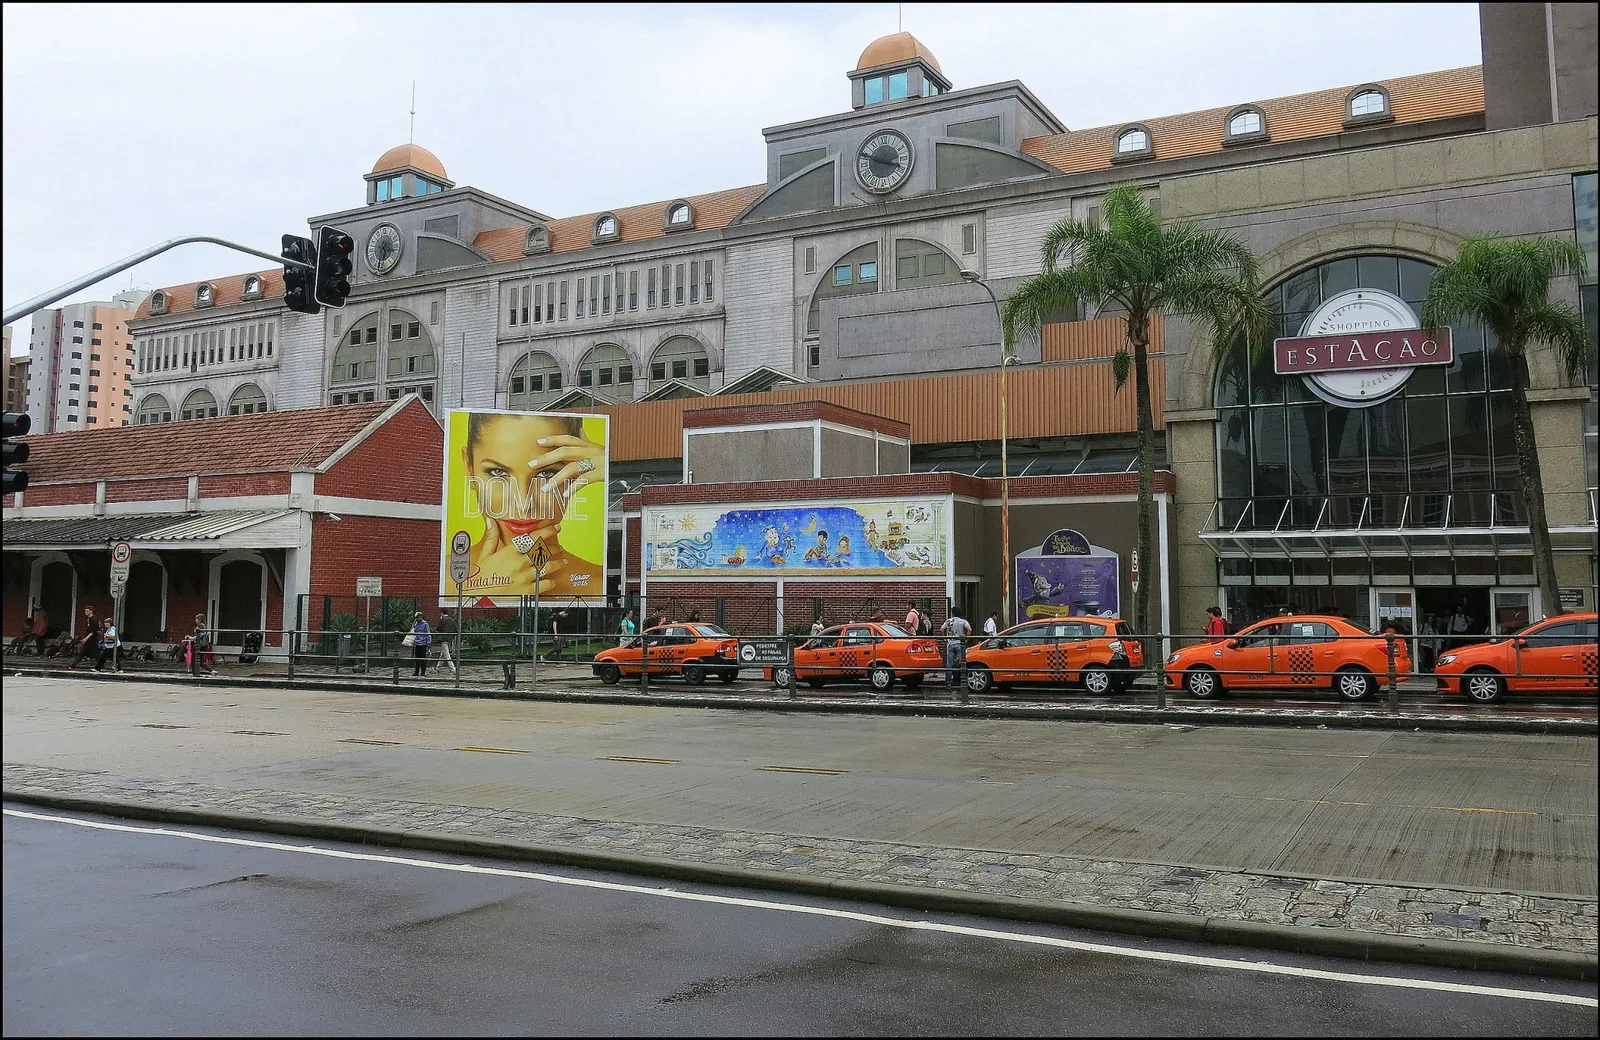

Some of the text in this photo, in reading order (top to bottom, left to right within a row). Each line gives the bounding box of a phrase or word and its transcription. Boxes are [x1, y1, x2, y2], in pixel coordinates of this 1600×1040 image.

[1329, 319, 1391, 332] SHOPPING
[1286, 337, 1438, 366] ESTAÇÃO
[463, 475, 589, 520] DOMINE
